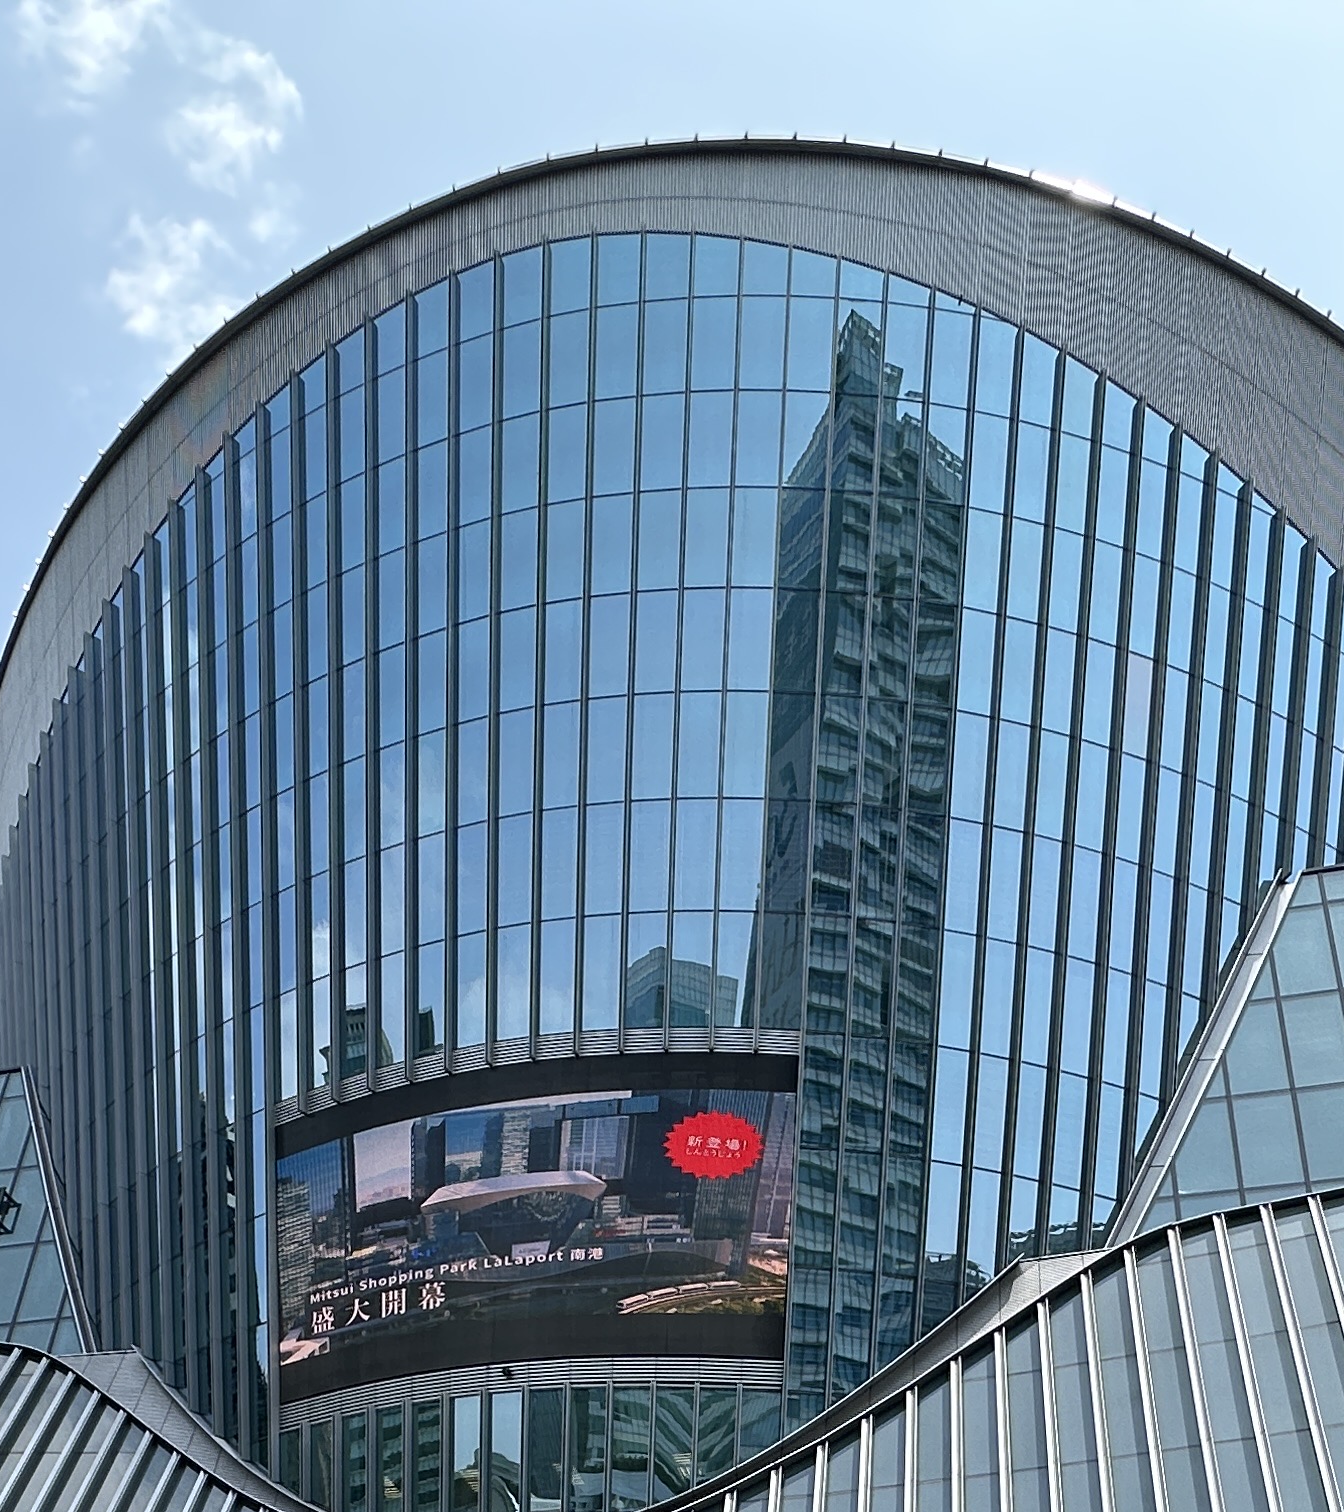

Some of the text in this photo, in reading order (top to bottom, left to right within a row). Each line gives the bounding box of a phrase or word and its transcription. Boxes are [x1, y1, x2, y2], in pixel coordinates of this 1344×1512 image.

[309, 1247, 604, 1304] Mitsui Shopping Park LaLaport 南港
[311, 1281, 446, 1335] 盛大開幕
